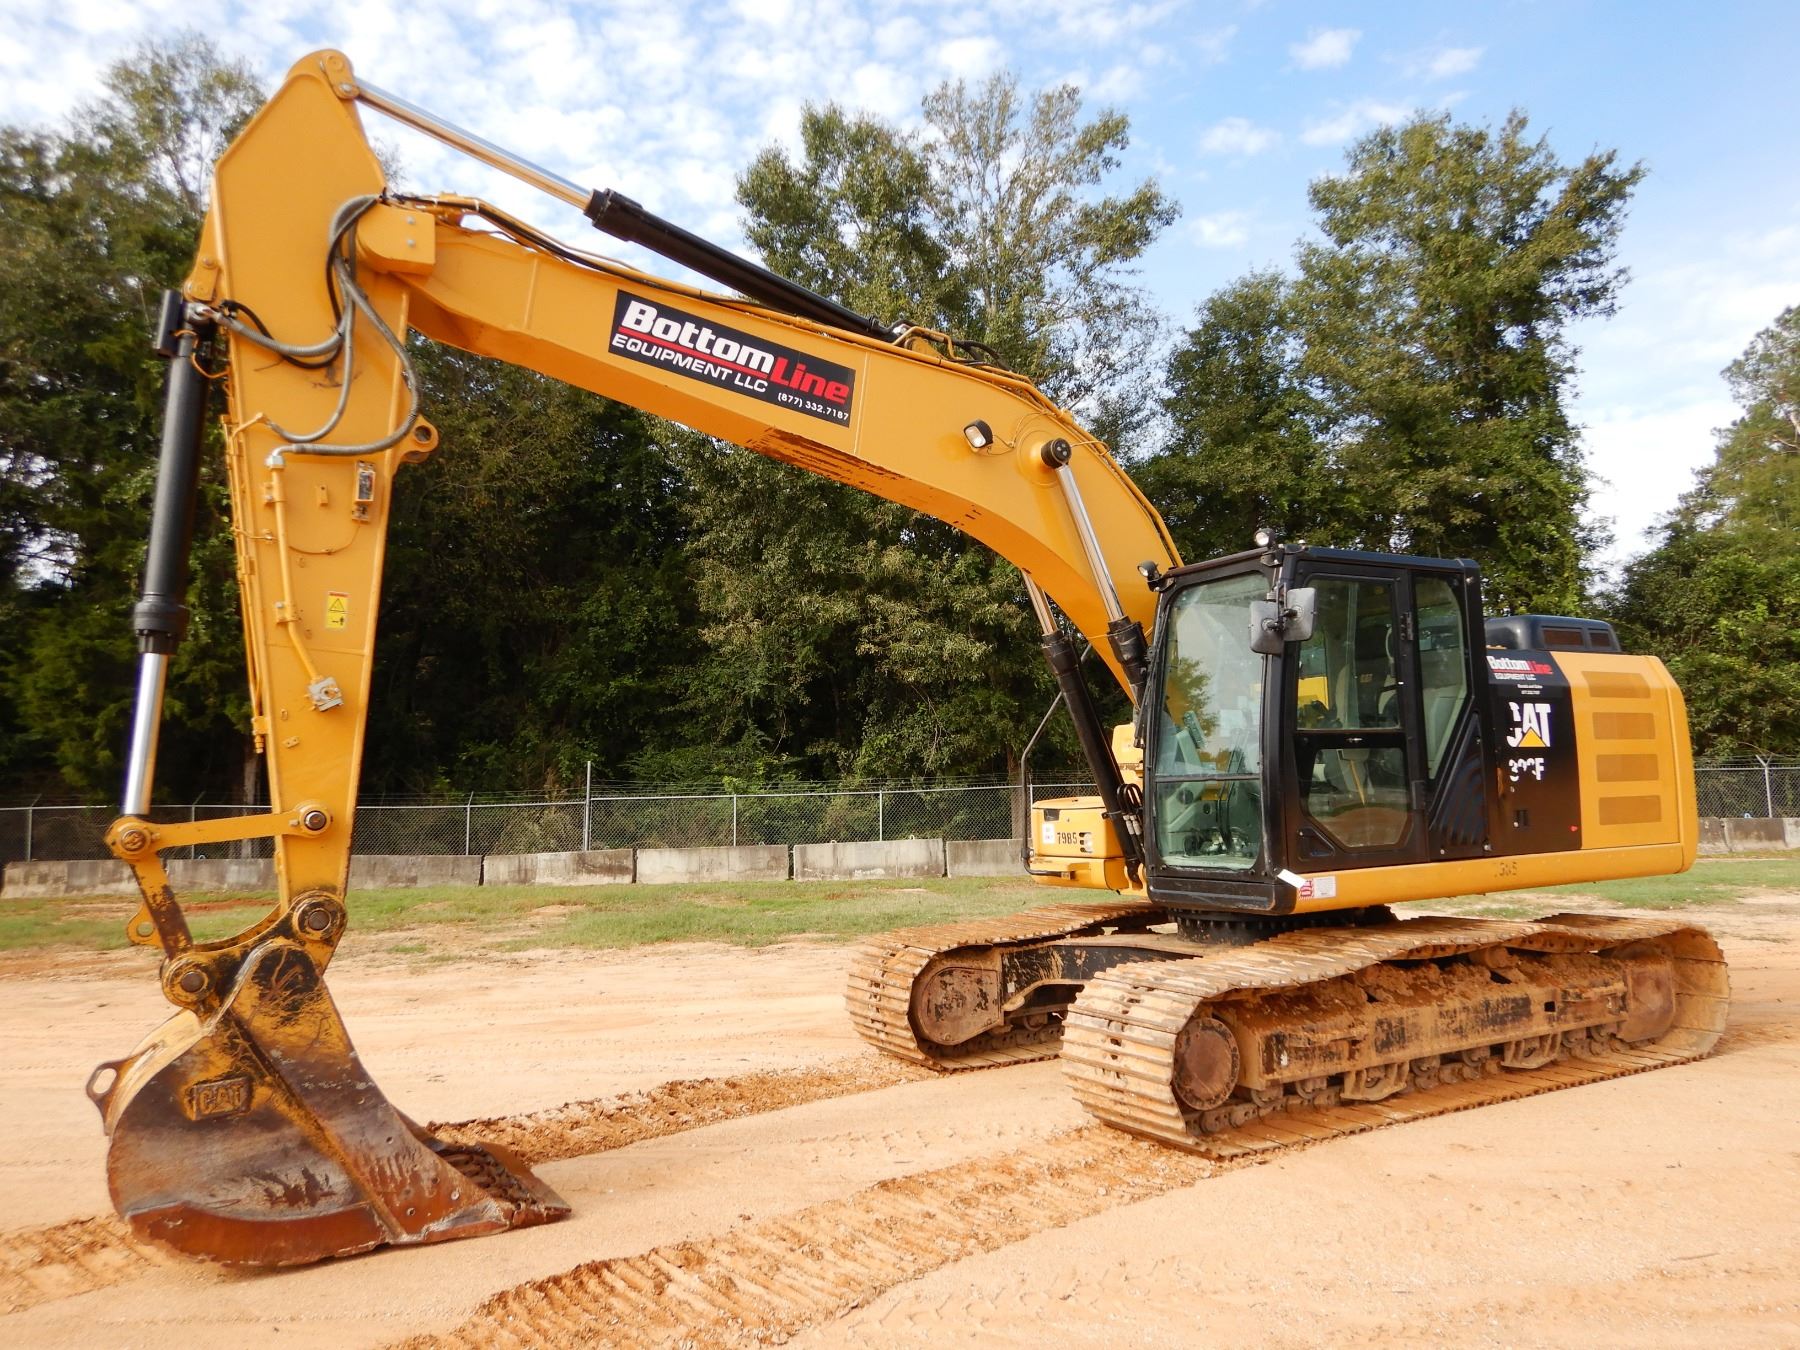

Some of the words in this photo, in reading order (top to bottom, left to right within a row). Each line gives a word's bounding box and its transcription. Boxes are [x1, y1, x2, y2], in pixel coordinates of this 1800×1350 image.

[611, 333, 733, 380] EQUIPMENT
[734, 372, 768, 393] LLC
[777, 392, 803, 408] (877)
[805, 401, 849, 420] 332.7187
[1506, 702, 1551, 747] CAT
[200, 1084, 242, 1115] CAT
